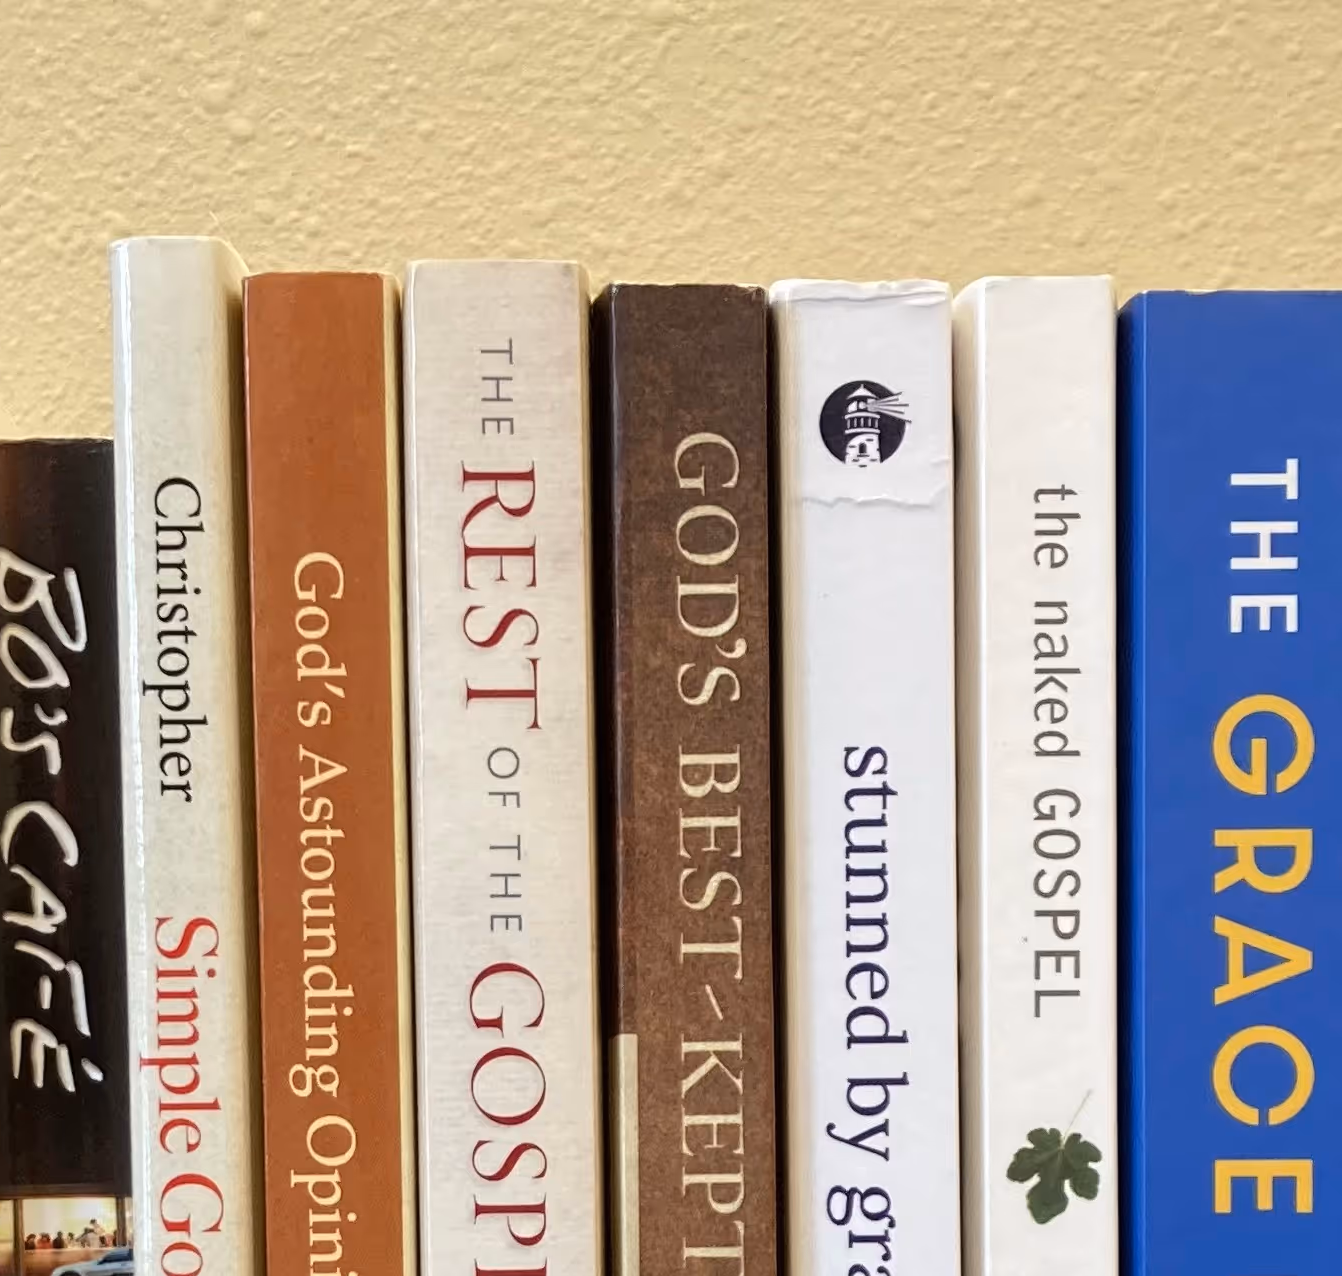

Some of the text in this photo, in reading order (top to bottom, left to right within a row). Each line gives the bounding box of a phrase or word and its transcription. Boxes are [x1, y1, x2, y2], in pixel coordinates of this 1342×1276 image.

[480, 337, 514, 436] THE
[141, 476, 210, 805] Christopher
[294, 550, 348, 730] God's
[459, 460, 542, 730] REST
[673, 431, 748, 709] GOD'S
[1230, 457, 1298, 634] THE
[486, 747, 521, 809] OF
[1033, 484, 1082, 1020] the naked GOSPEL
[288, 746, 355, 1097] Astounding
[489, 836, 523, 933] THE
[844, 746, 907, 1050] stunned
[1211, 691, 1316, 1215] GRACE
[140, 916, 221, 1155] Simple
[828, 1071, 909, 1162] by
